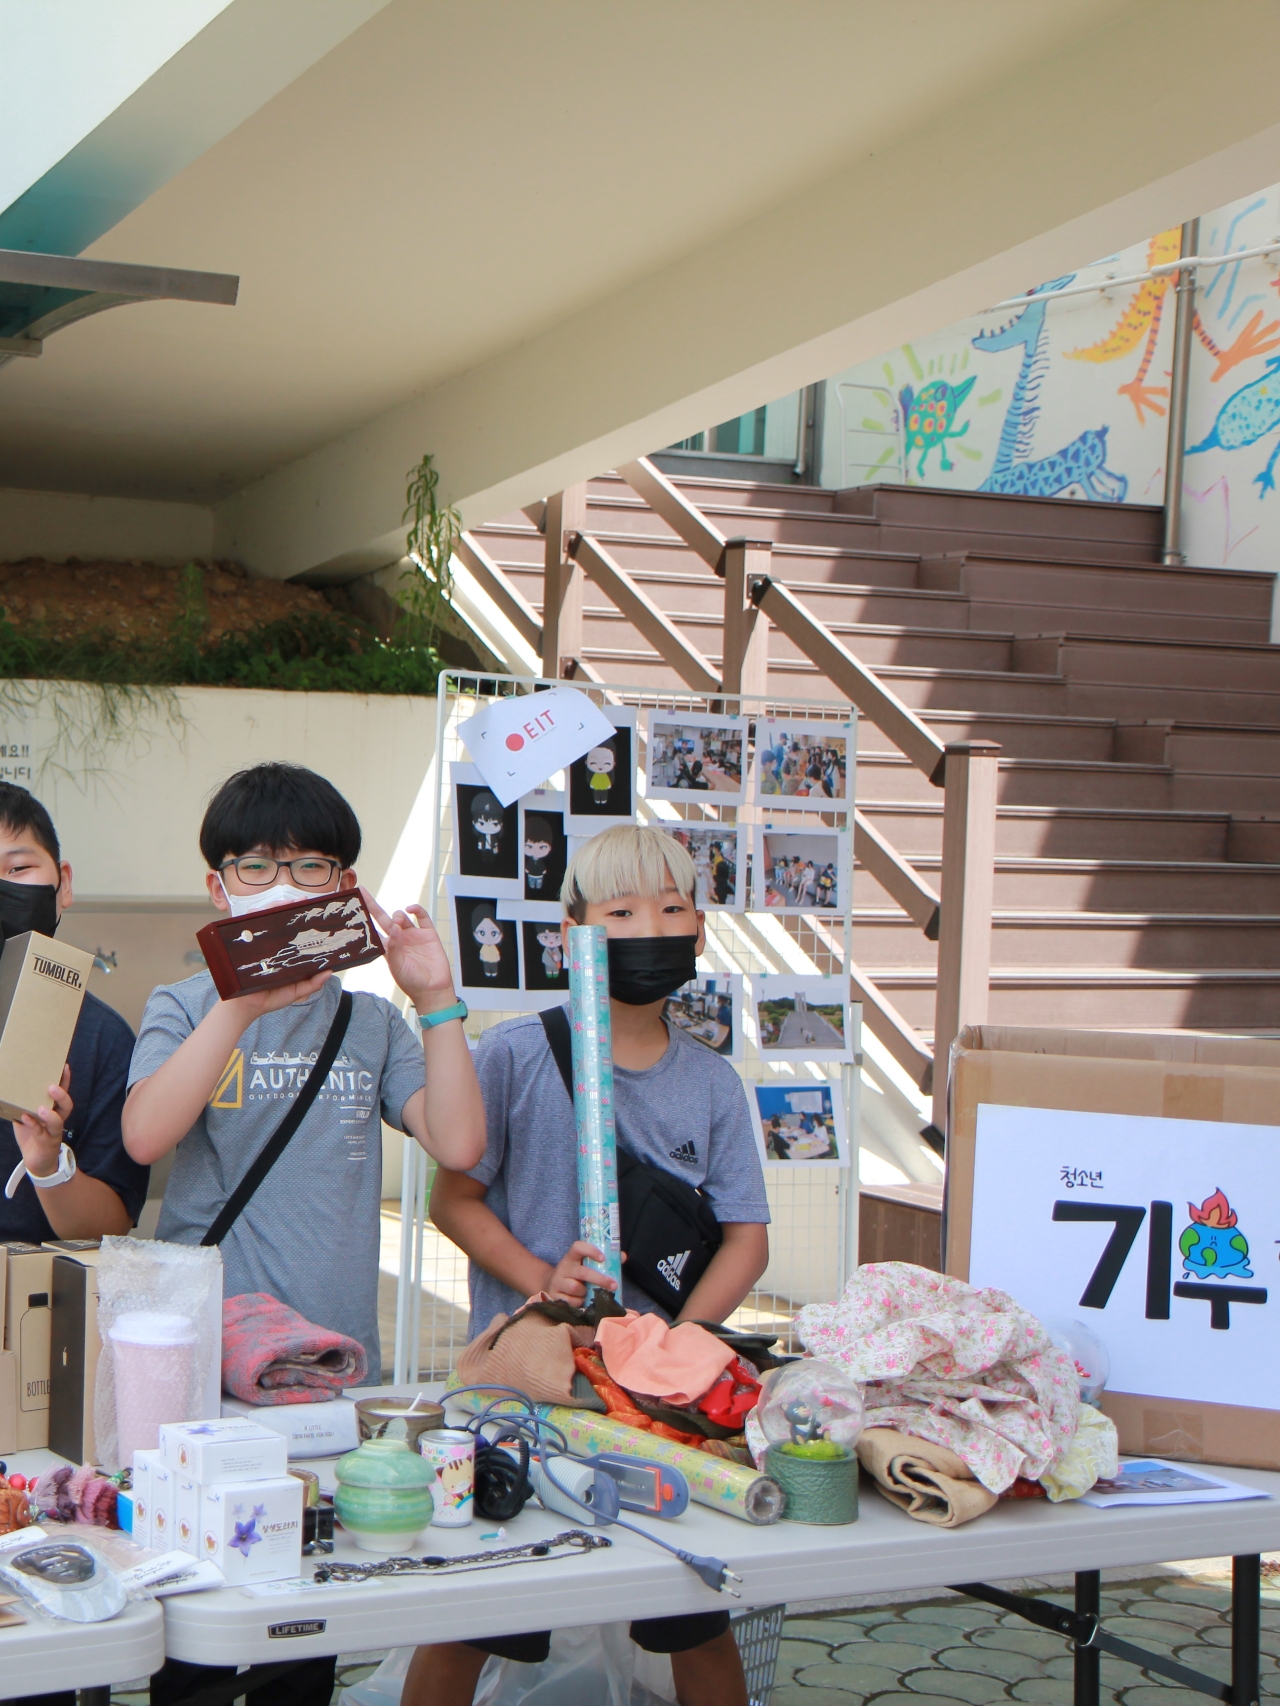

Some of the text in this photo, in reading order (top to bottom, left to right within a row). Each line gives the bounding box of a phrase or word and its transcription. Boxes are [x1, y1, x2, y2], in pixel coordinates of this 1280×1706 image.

[523, 709, 555, 739] EIT
[250, 1051, 351, 1067] EXPLOE
[249, 1068, 373, 1091] AUTHNTC
[249, 1091, 300, 1101] OUTDOO
[669, 1151, 699, 1164] adidas
[1060, 1166, 1104, 1188] 청소년
[657, 1259, 681, 1291] adidas
[275, 1622, 320, 1635] LIFETIME
